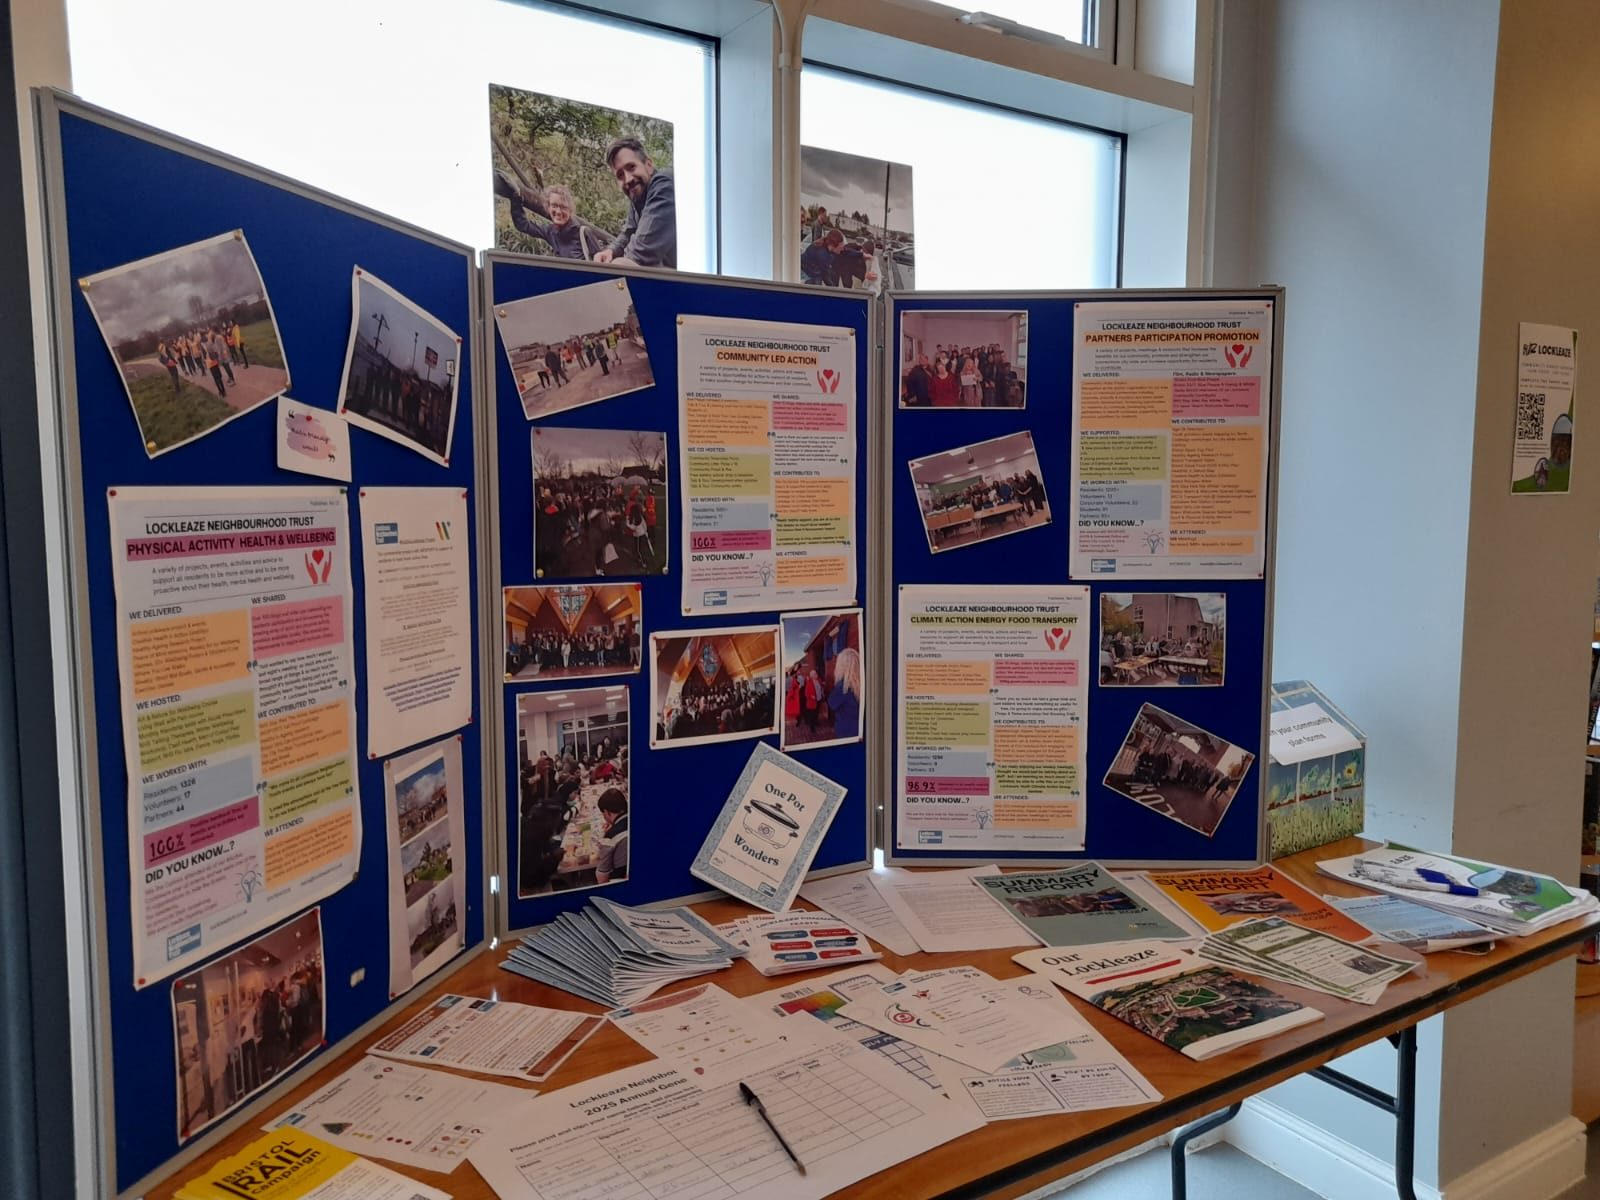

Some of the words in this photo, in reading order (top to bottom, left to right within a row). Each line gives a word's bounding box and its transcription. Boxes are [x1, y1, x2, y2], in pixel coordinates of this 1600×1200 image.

[1102, 322, 1146, 330] LOCKLEAZE
[1146, 322, 1216, 330] NEIGHBOURHOOD
[1217, 321, 1242, 329] TRUST
[705, 338, 746, 348] LOCKLEAZE
[747, 341, 808, 352] NEIGHBOURHOOD
[809, 345, 830, 353] TRUST
[1085, 333, 1133, 343] PARTNERS
[1134, 332, 1202, 342] PARTICIPATION
[1203, 332, 1259, 341] PROMOTION
[717, 351, 770, 363] COMMUNITY
[771, 355, 785, 364] LED
[787, 356, 817, 365] ACTION
[146, 520, 205, 534] LOCKLEAZE
[207, 517, 288, 531] NEIGHBOURHOOD
[289, 516, 315, 526] TRUST
[127, 541, 186, 556] PHYSICAL
[189, 537, 235, 552] ACTIVITY
[240, 534, 276, 548] HEALTH
[278, 534, 285, 546] &
[286, 531, 336, 545] WELLBEING
[691, 554, 704, 562] DID
[252, 597, 260, 605] WE
[129, 611, 142, 620] WE
[910, 616, 943, 624] CLIMATE
[945, 616, 974, 624] ACTION
[975, 616, 1006, 624] ENERGY
[1008, 616, 1031, 624] FOOD
[1032, 616, 1078, 624] TRANSPORT
[136, 701, 149, 710] WE
[258, 710, 268, 719] WE
[268, 702, 307, 717] CONTRIBUTED
[142, 775, 155, 785] WE
[155, 765, 188, 781] WORKED
[764, 783, 787, 799] One
[787, 792, 806, 812] Pot
[264, 828, 273, 838] WE
[734, 833, 779, 866] Wonders
[145, 869, 164, 884] DID
[165, 860, 189, 878] YOU
[983, 869, 1100, 888] SUMMARY
[1155, 872, 1275, 886] SUMMARY
[1004, 878, 1097, 894] REPORT
[1175, 881, 1272, 892] REPORT
[1041, 953, 1081, 966] Our
[1058, 948, 1159, 976] Lockleaze
[569, 1085, 627, 1109] Lockleaze
[584, 1102, 618, 1116] 2025
[619, 1087, 658, 1104] Annual
[658, 1077, 688, 1091] Gene
[510, 1140, 537, 1153] Please
[557, 1128, 572, 1137] and
[573, 1122, 589, 1133] sign
[589, 1116, 606, 1127] your
[222, 1139, 295, 1182] BRISTOL
[232, 1148, 314, 1191] RAIL
